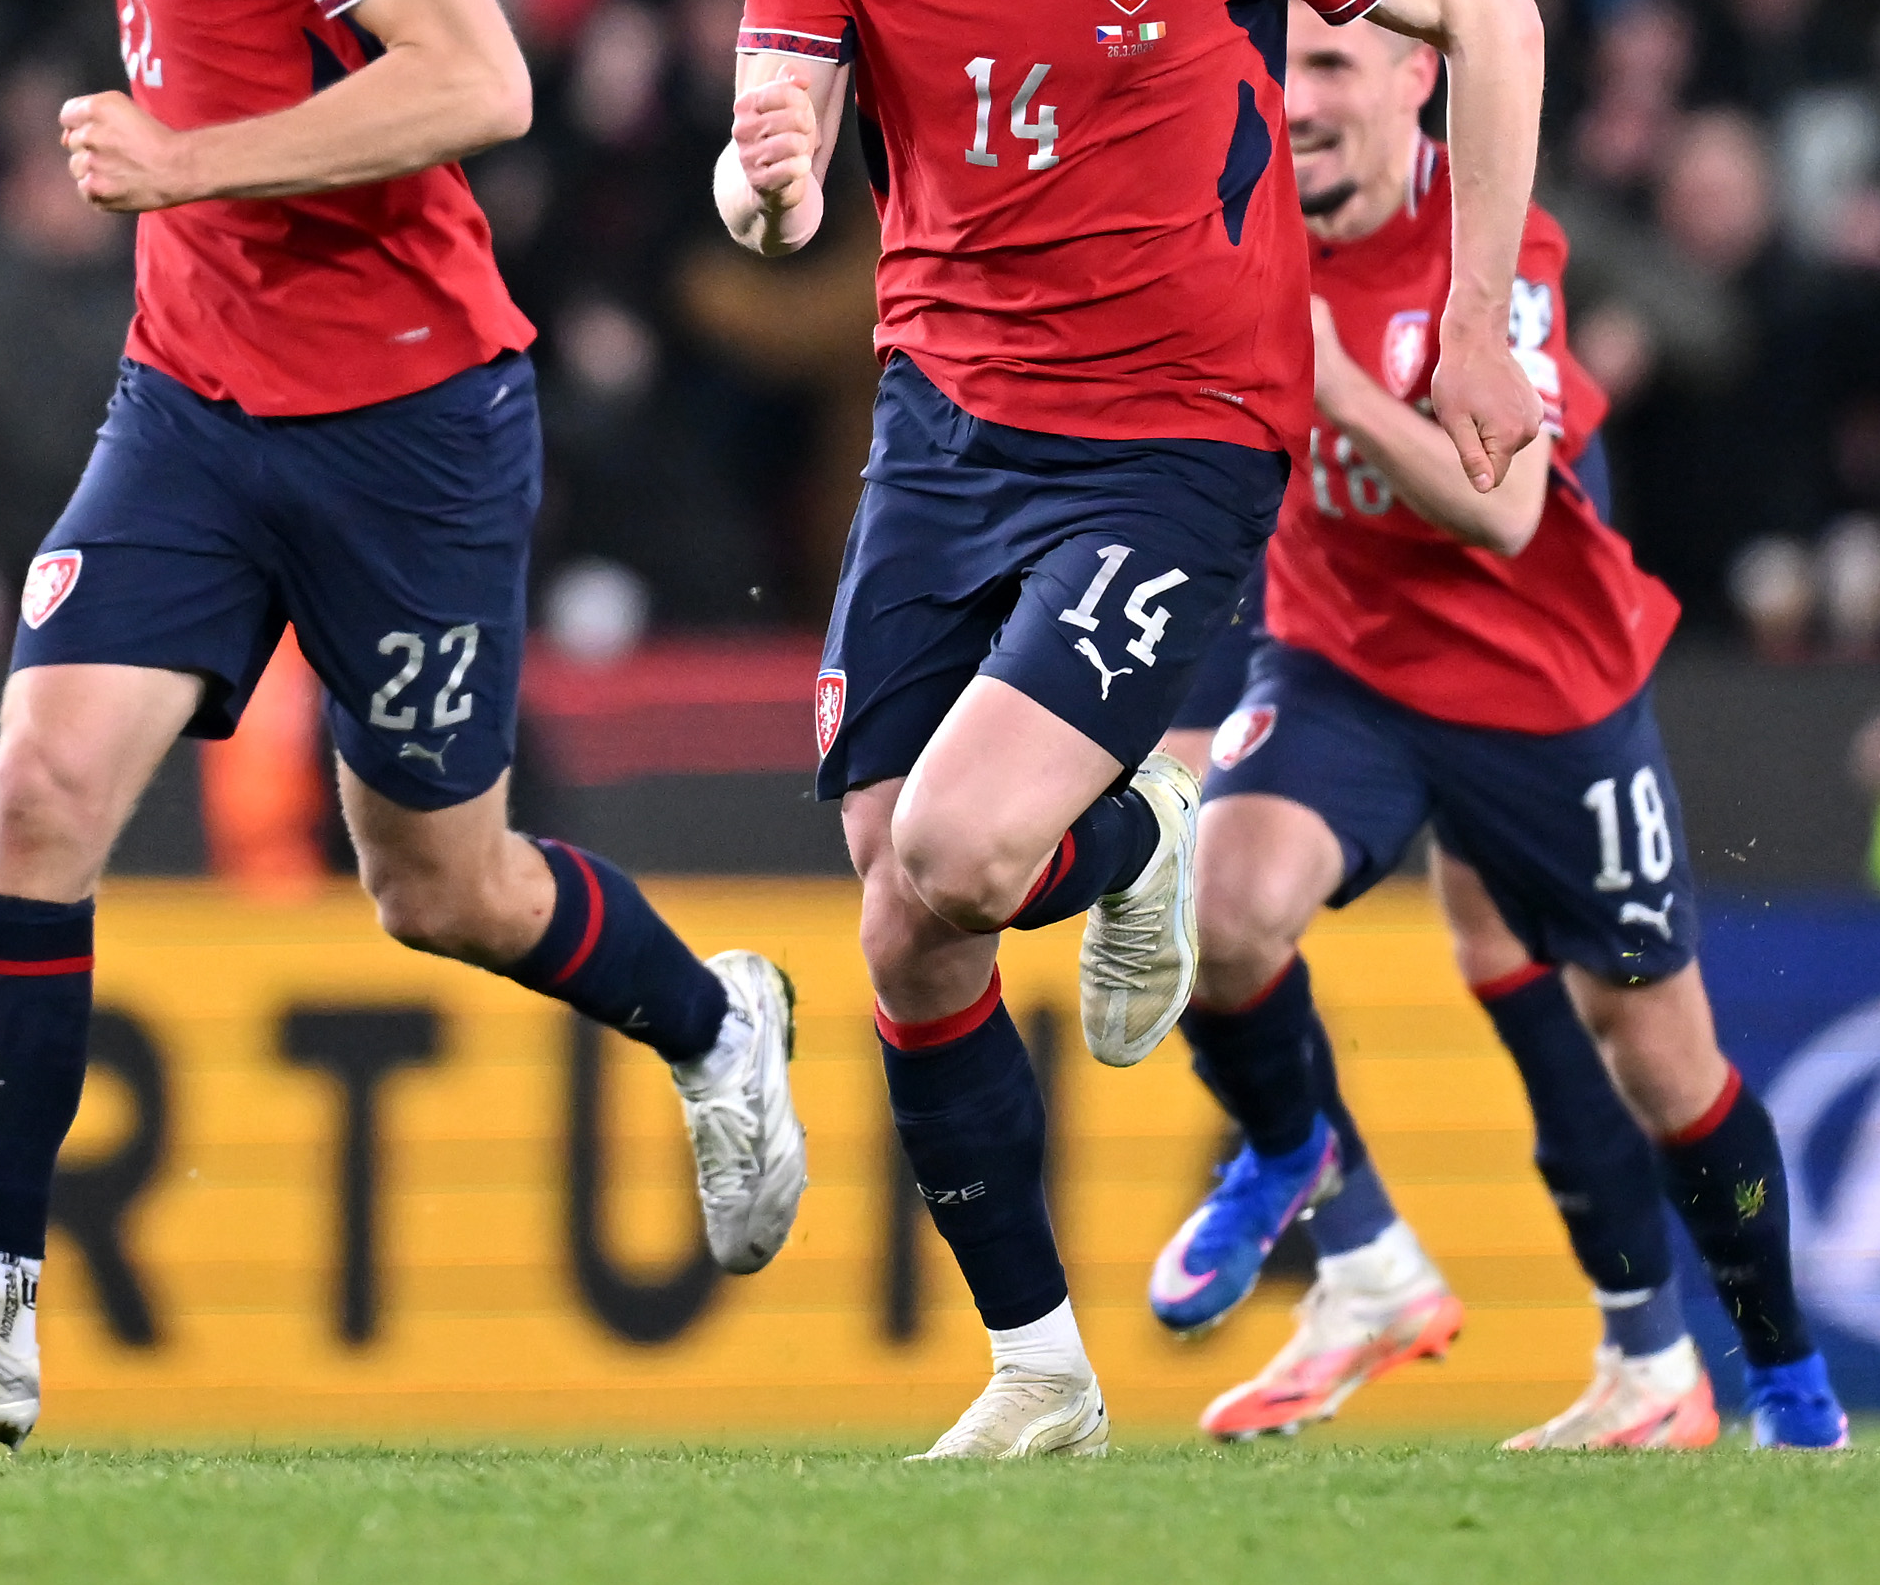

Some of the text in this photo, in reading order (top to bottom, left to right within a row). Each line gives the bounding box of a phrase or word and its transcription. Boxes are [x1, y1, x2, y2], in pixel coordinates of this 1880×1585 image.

[964, 57, 1059, 170] 14
[1310, 427, 1393, 518] 18
[1058, 544, 1189, 668] 14
[370, 623, 479, 730] 22
[1583, 765, 1674, 892] 18
[917, 1181, 986, 1204] CZE
